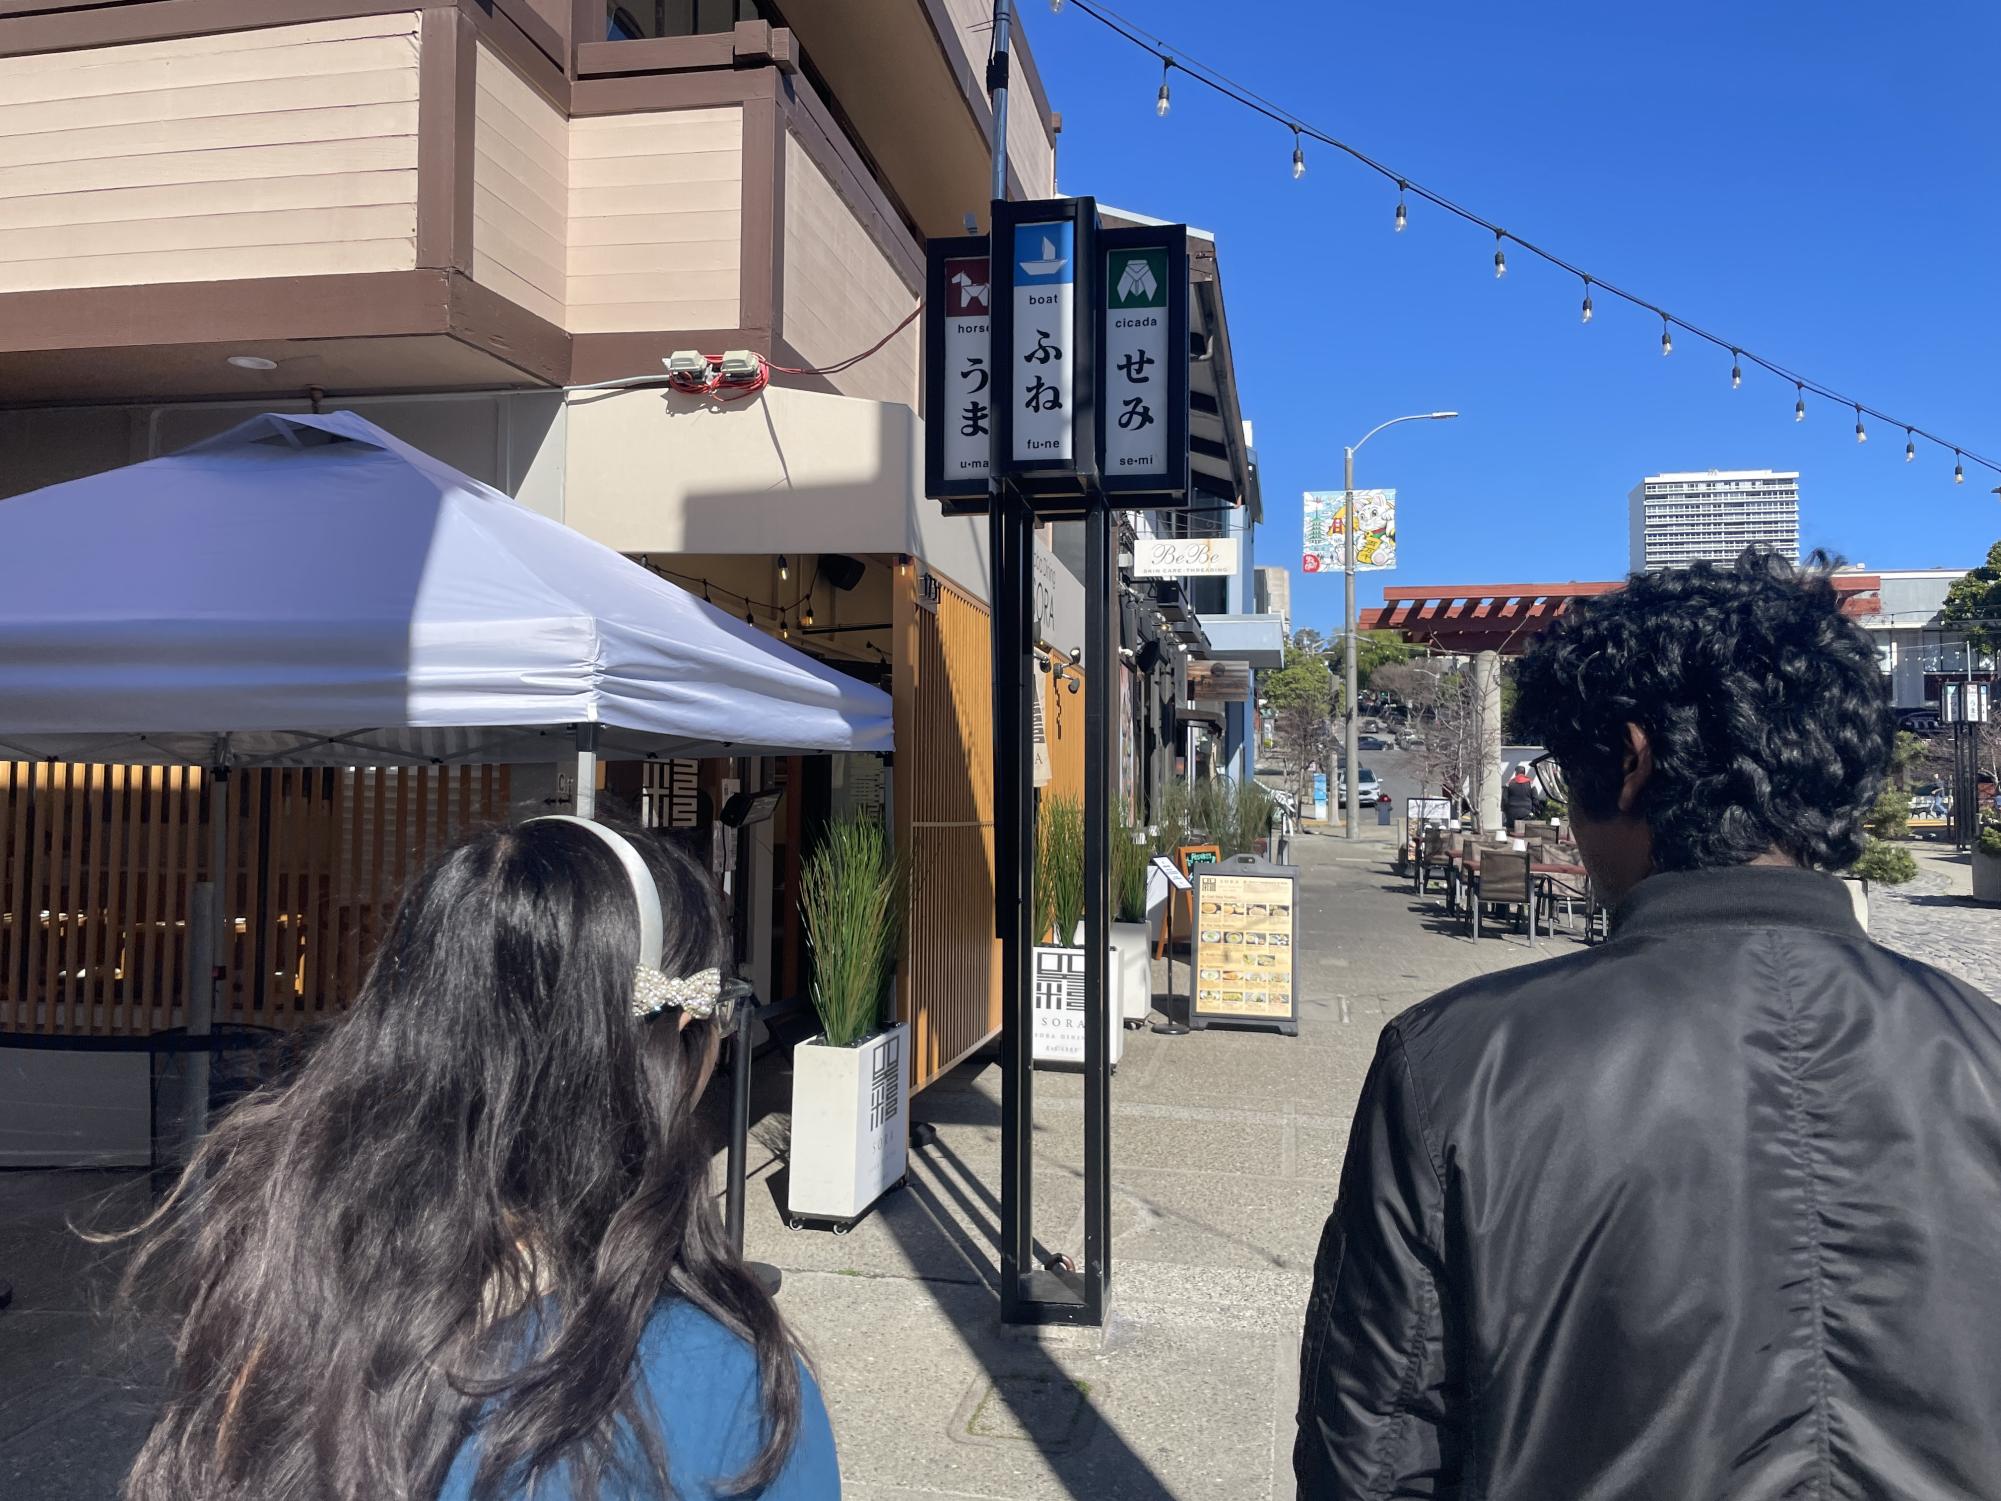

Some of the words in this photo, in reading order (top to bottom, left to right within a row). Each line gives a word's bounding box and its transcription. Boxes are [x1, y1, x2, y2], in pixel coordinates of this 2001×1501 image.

[1029, 294, 1059, 305] boat
[1115, 316, 1158, 328] cicada
[1024, 329, 1063, 413] ふね
[1116, 348, 1155, 431] せみ
[960, 357, 989, 437] うま
[1041, 1017, 1085, 1028] SORA
